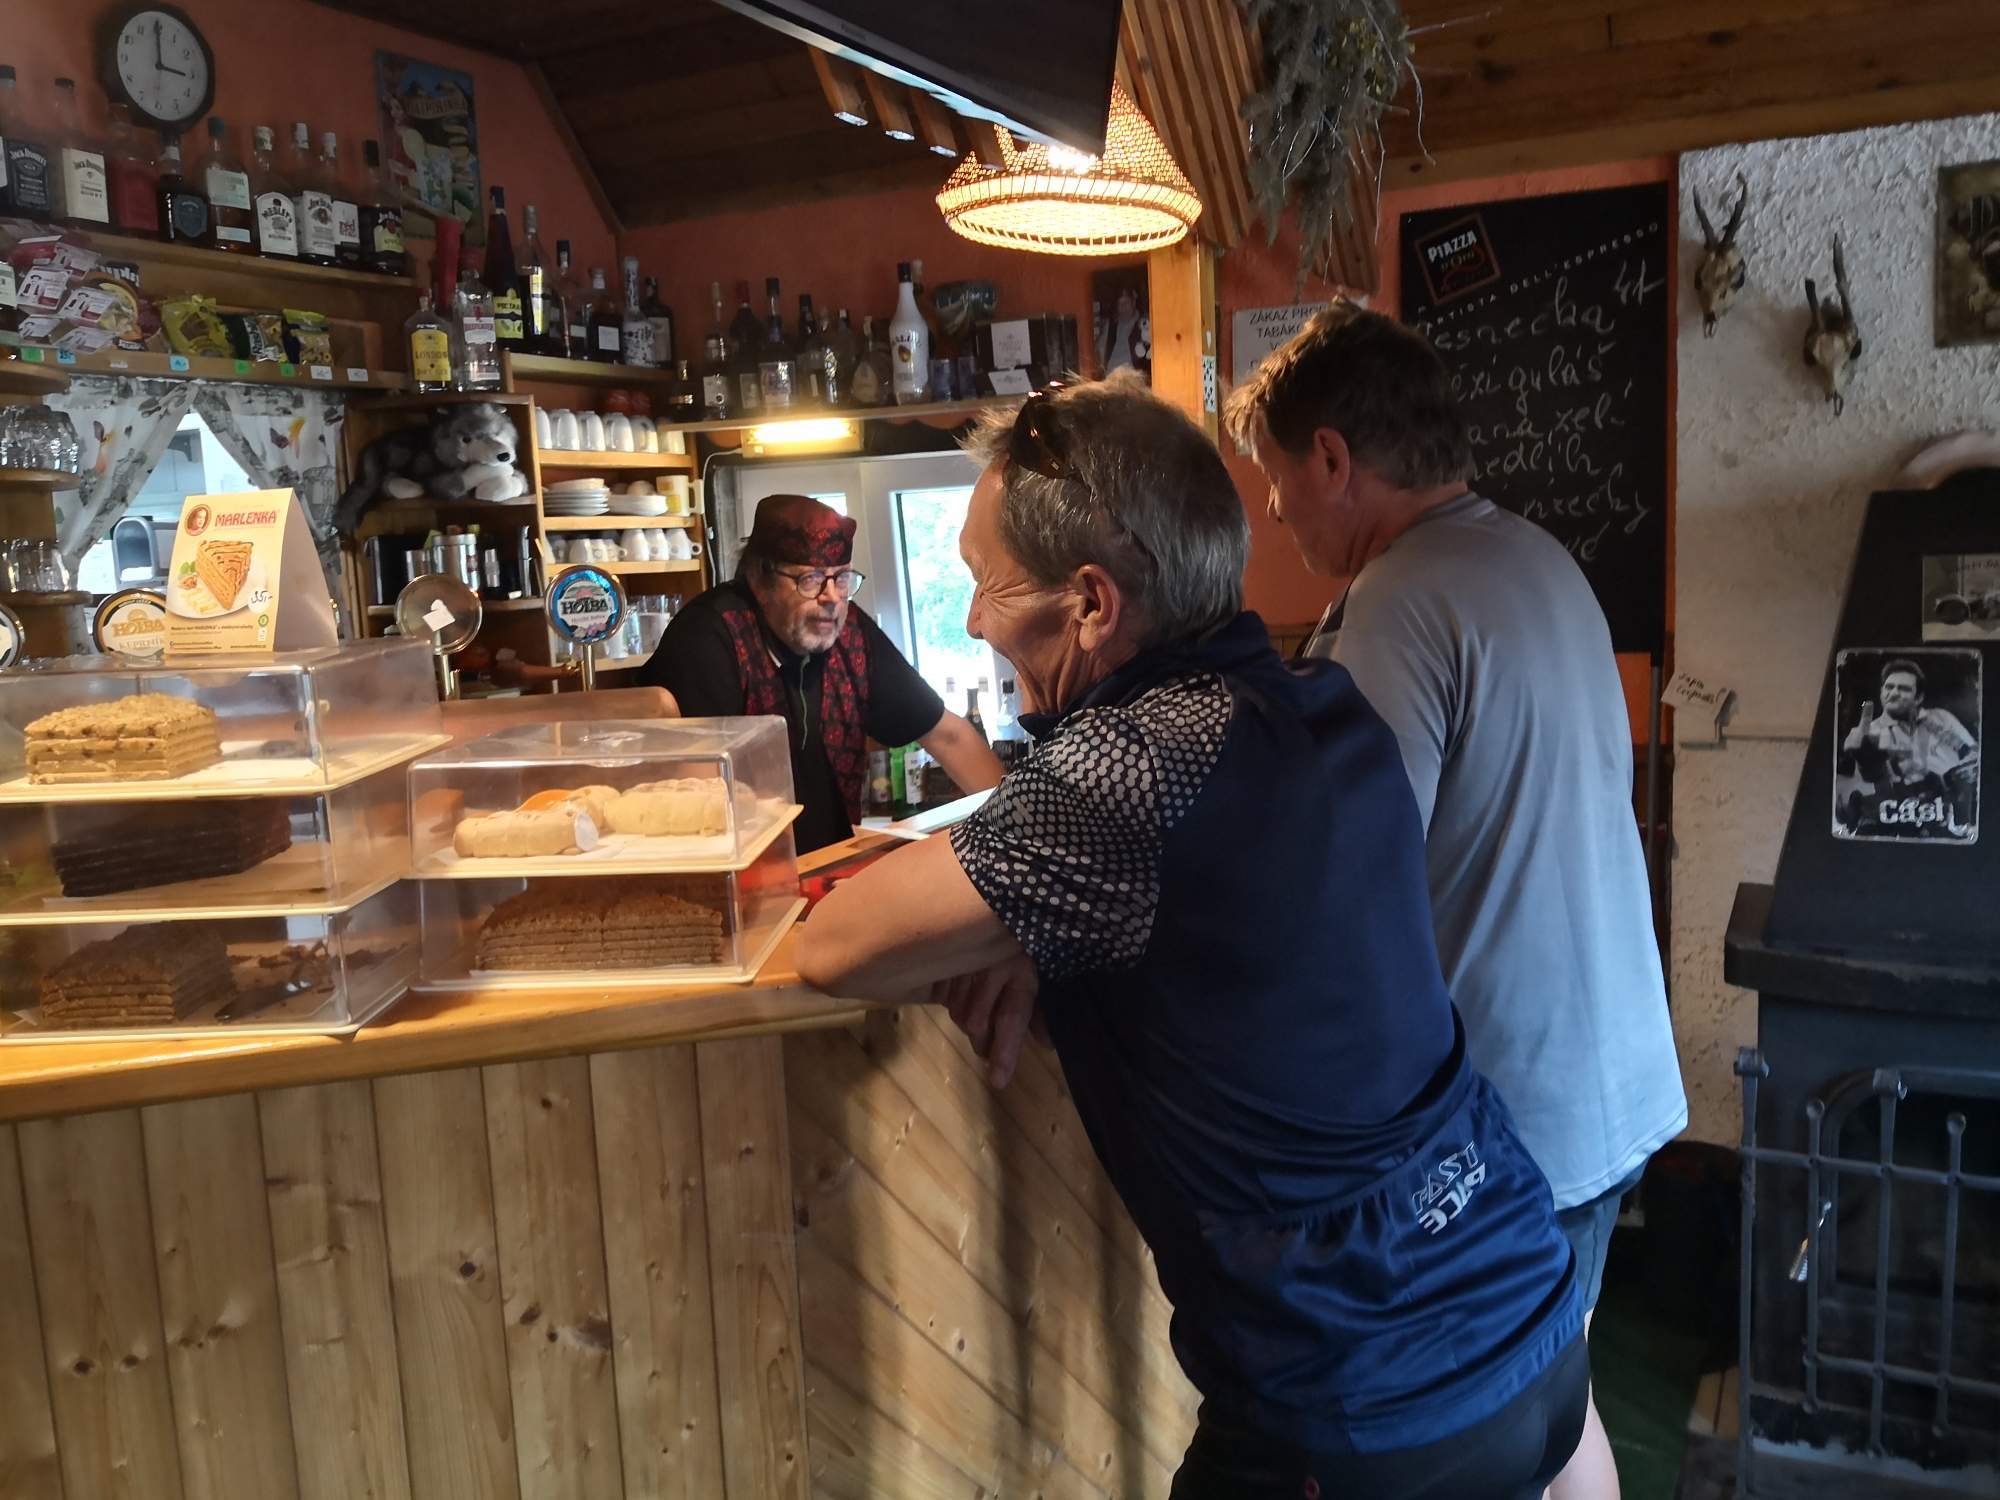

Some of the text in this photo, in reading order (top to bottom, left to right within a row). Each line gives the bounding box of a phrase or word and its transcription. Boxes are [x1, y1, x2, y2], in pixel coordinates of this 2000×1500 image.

[1427, 229, 1478, 263] PIAZZA
[214, 510, 278, 528] MARLENKA
[561, 598, 609, 615] HOLBA
[112, 619, 165, 637] HOLBA
[1411, 1140, 1479, 1216] FAST
